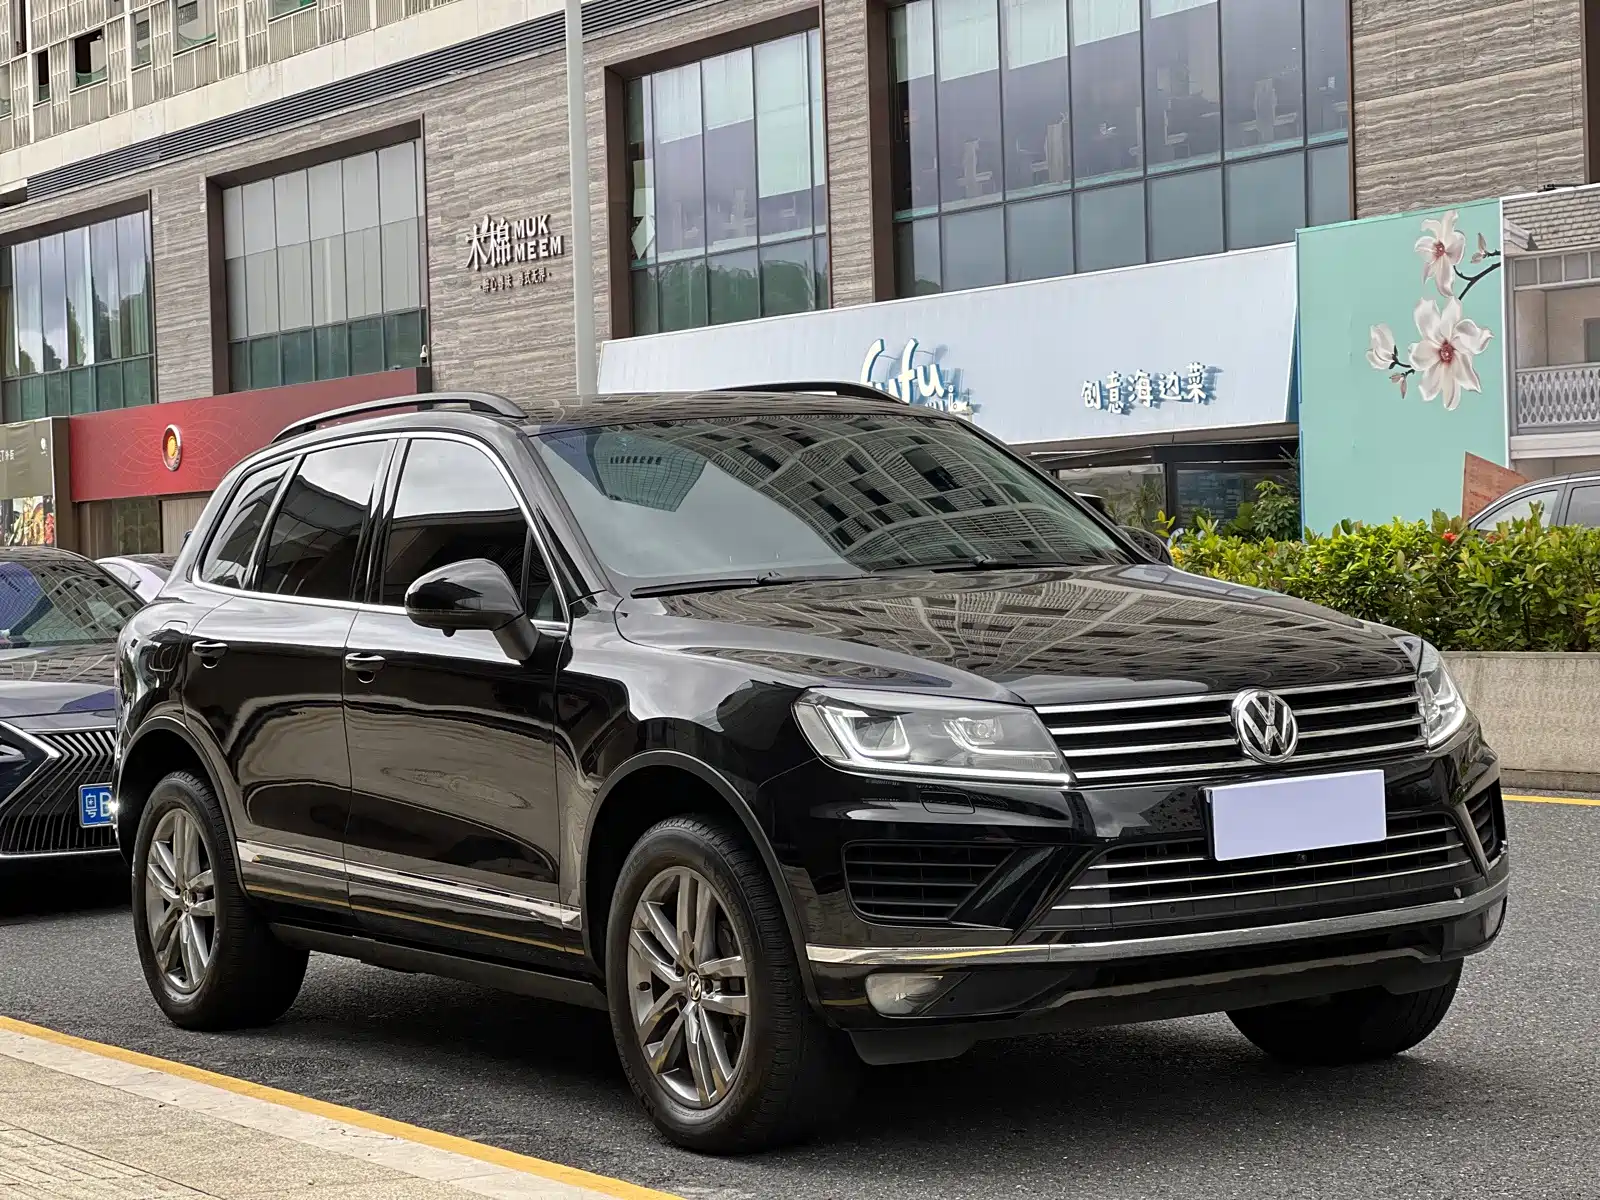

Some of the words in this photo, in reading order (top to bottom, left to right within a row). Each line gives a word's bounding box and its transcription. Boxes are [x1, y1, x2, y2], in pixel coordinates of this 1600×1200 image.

[514, 214, 551, 240] MUK
[514, 235, 564, 263] MEEM
[1081, 361, 1207, 414] 创意海边菜
[1238, 691, 1296, 761] VW
[85, 792, 113, 818] 粤B
